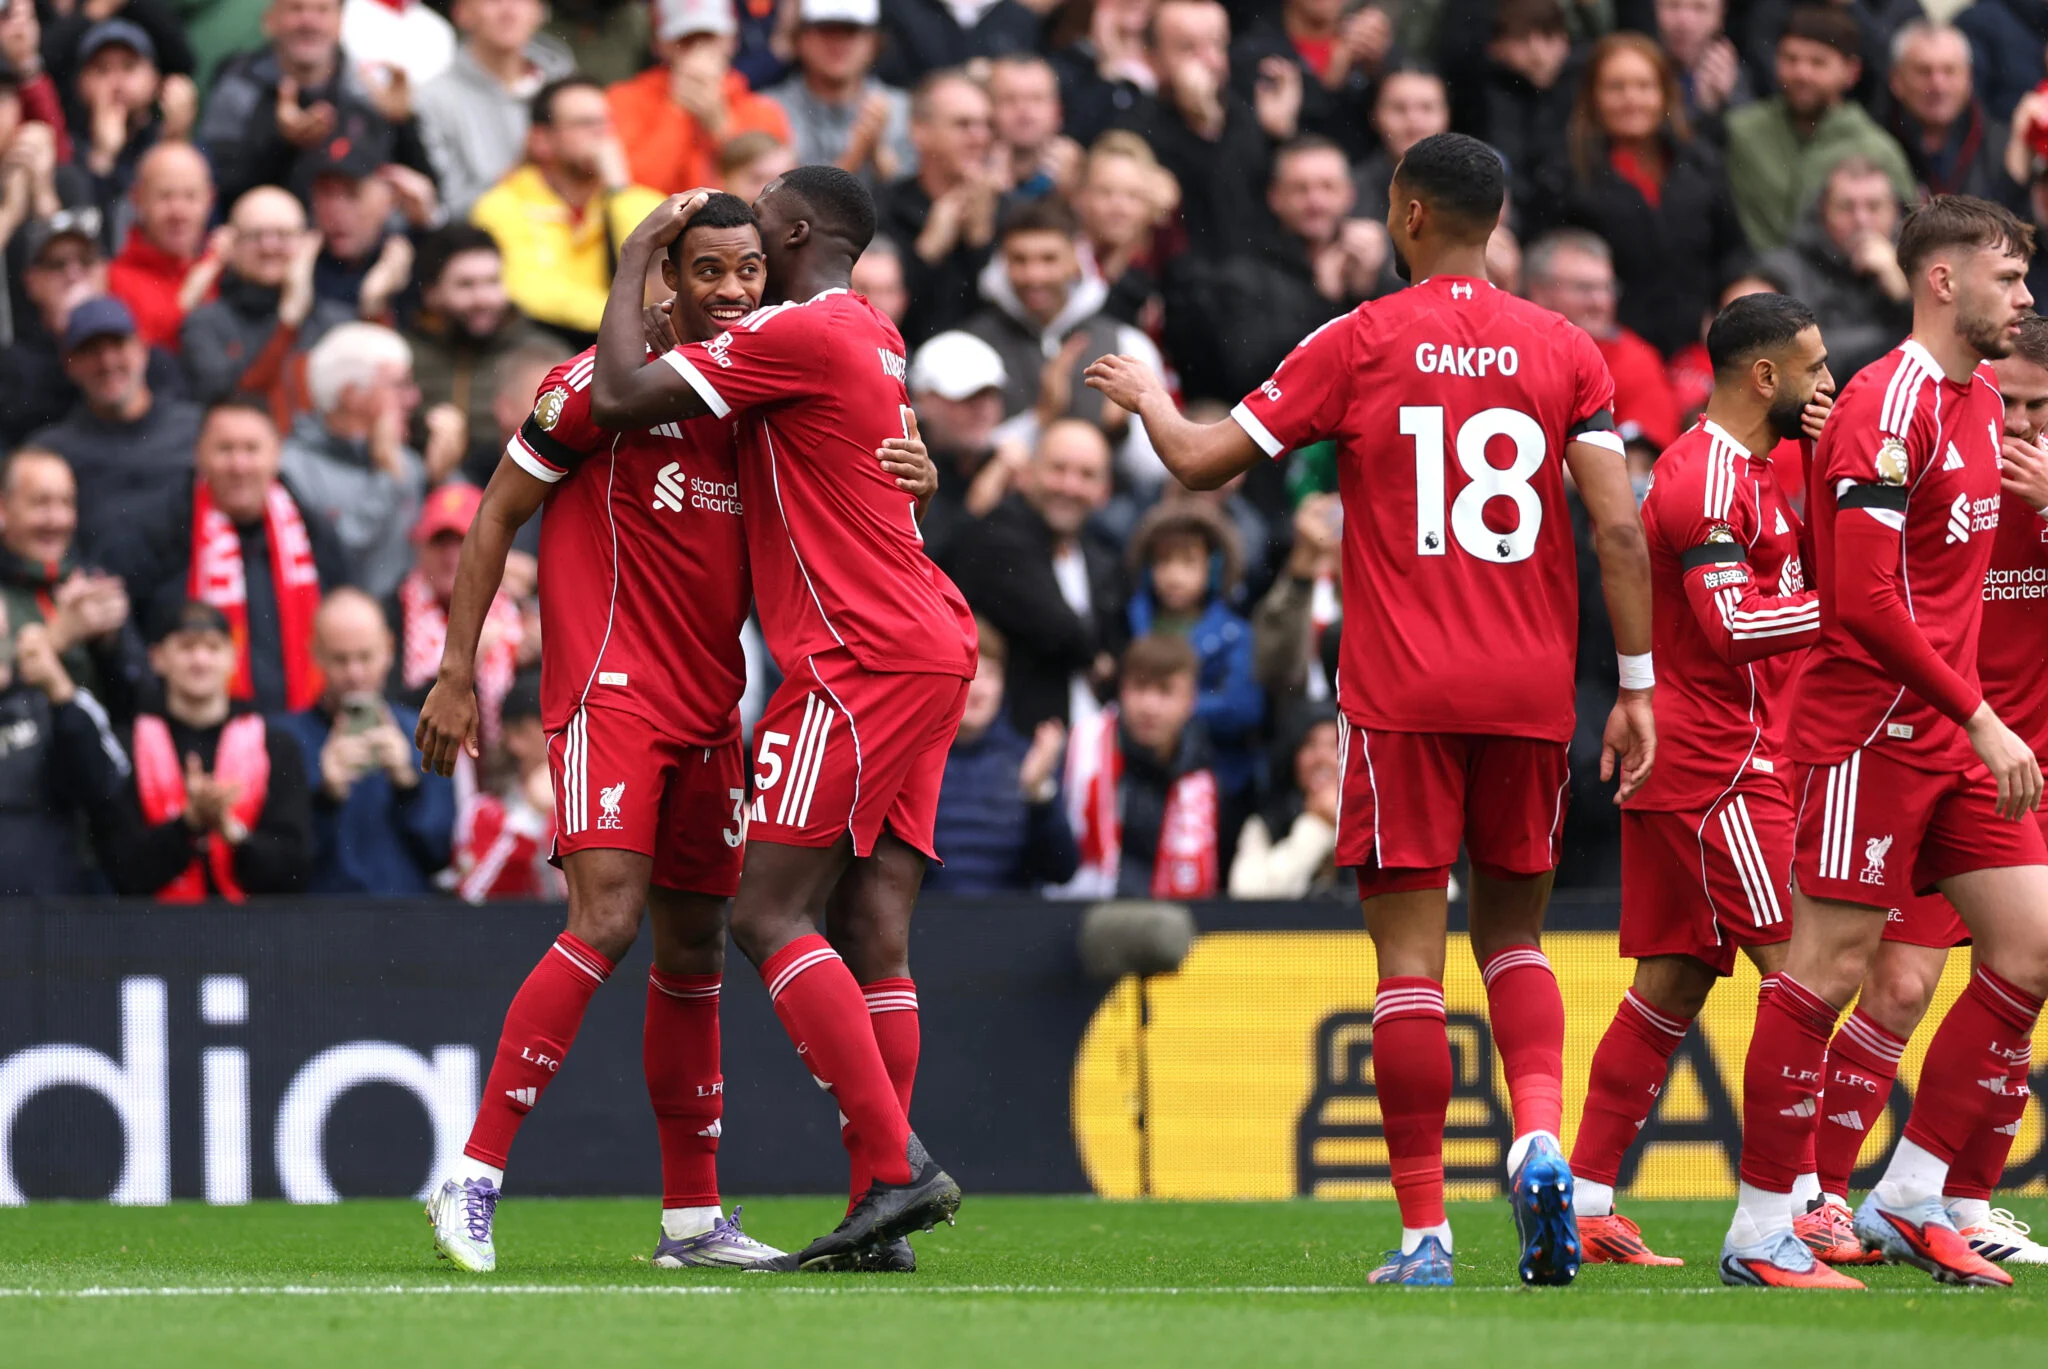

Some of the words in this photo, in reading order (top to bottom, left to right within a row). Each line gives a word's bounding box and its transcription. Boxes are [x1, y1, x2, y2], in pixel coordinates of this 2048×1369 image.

[1415, 342, 1519, 377] GAKPO
[690, 476, 738, 498] stand
[1398, 405, 1547, 564] 18
[691, 493, 743, 516] charte
[1703, 572, 1718, 582] No
[1718, 569, 1743, 579] room
[754, 730, 791, 791] 5
[723, 788, 745, 848] 3
[521, 1047, 559, 1072] LFC
[1835, 1070, 1877, 1093] LFC
